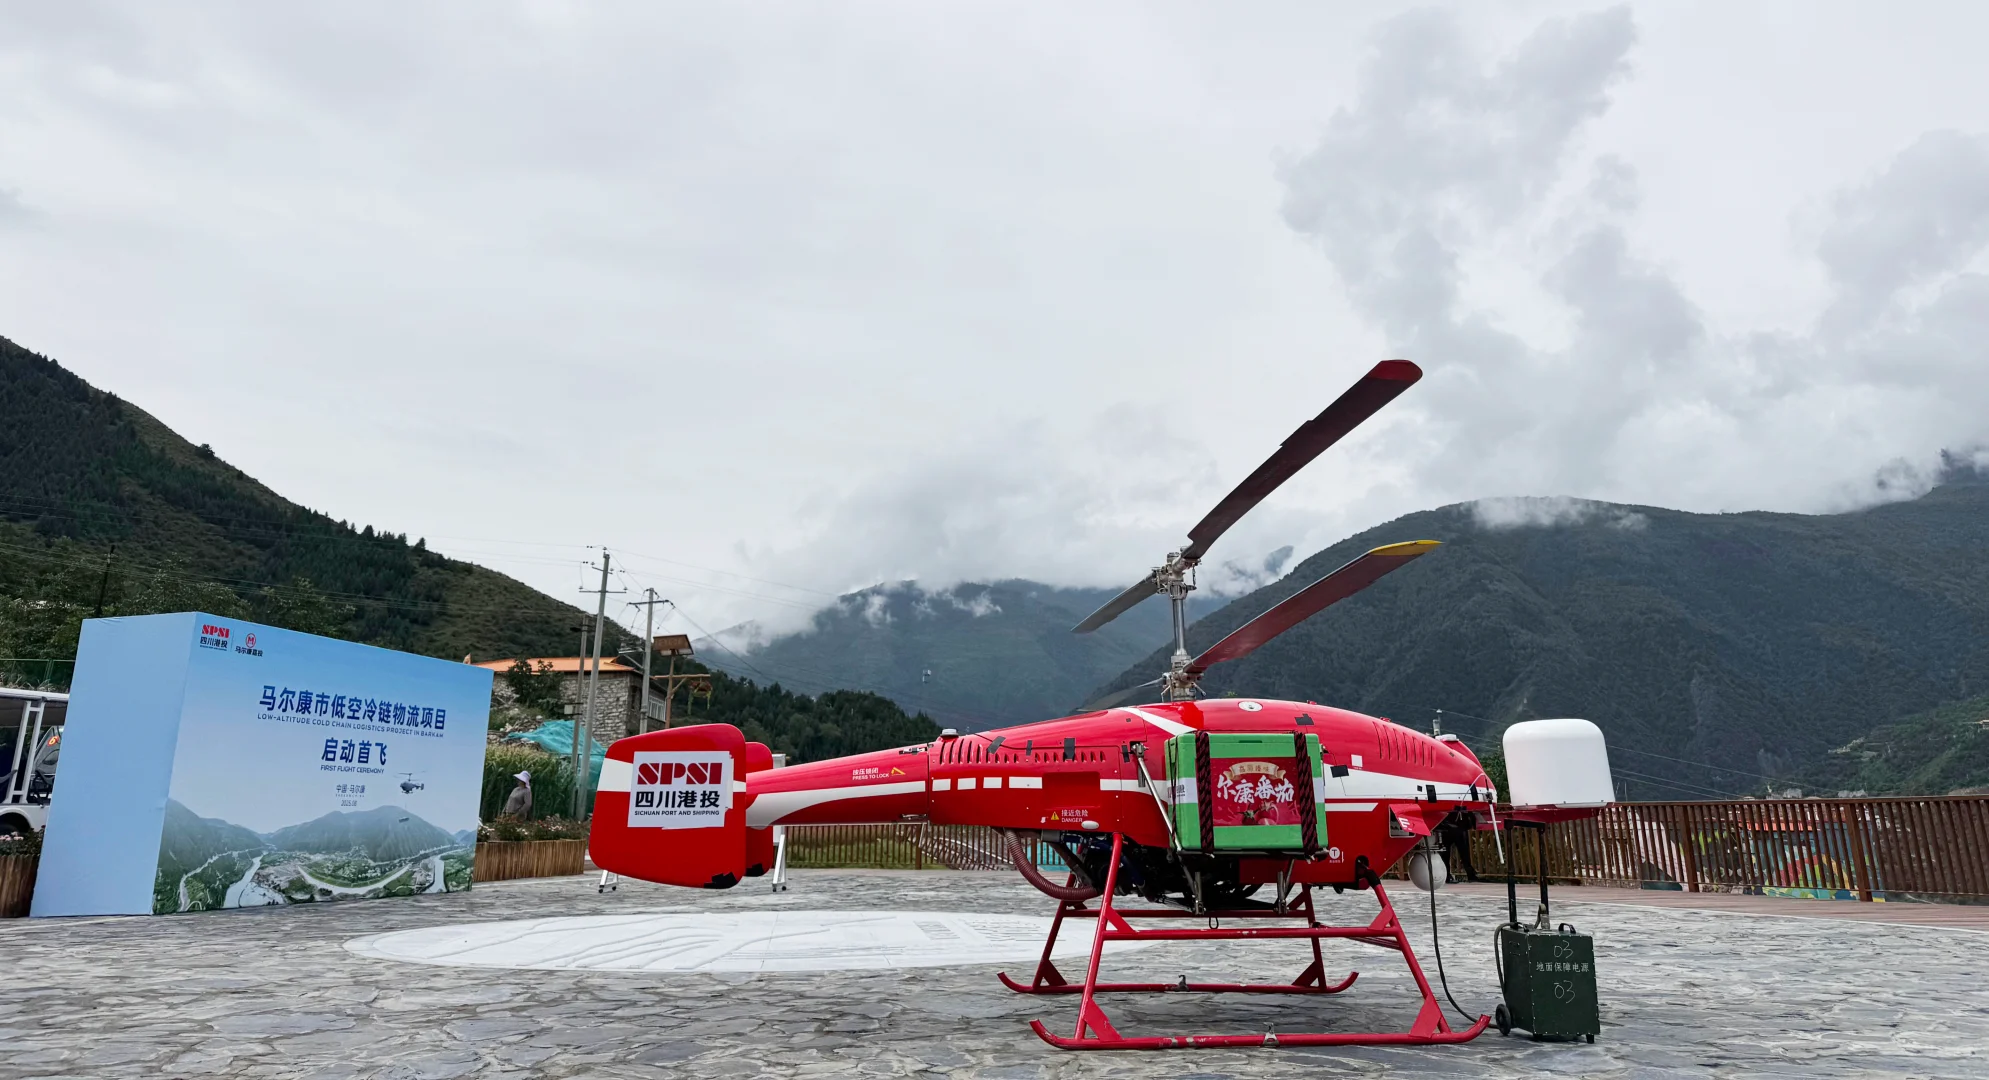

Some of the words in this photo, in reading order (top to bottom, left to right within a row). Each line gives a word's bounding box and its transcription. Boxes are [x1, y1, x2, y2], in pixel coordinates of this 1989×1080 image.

[201, 624, 230, 639] SPSI
[259, 685, 446, 730] 马尔康市低空冷链物流项目
[257, 713, 310, 725] LOW-ALTITUDE
[312, 718, 331, 727] COLD
[331, 720, 352, 729] CHAIN
[353, 723, 385, 732] LOGISTICS
[386, 727, 412, 735] PROJECT
[321, 737, 387, 766] 启动首飞
[320, 764, 336, 772] FIRST
[337, 765, 355, 773] FLIGHT
[356, 766, 385, 774] CEREMONY
[637, 762, 723, 785] SPSI
[635, 790, 720, 808] 四川港投
[1554, 940, 1574, 959] 03
[1536, 961, 1590, 973] 地面保障电源
[1554, 980, 1576, 1004] 03
